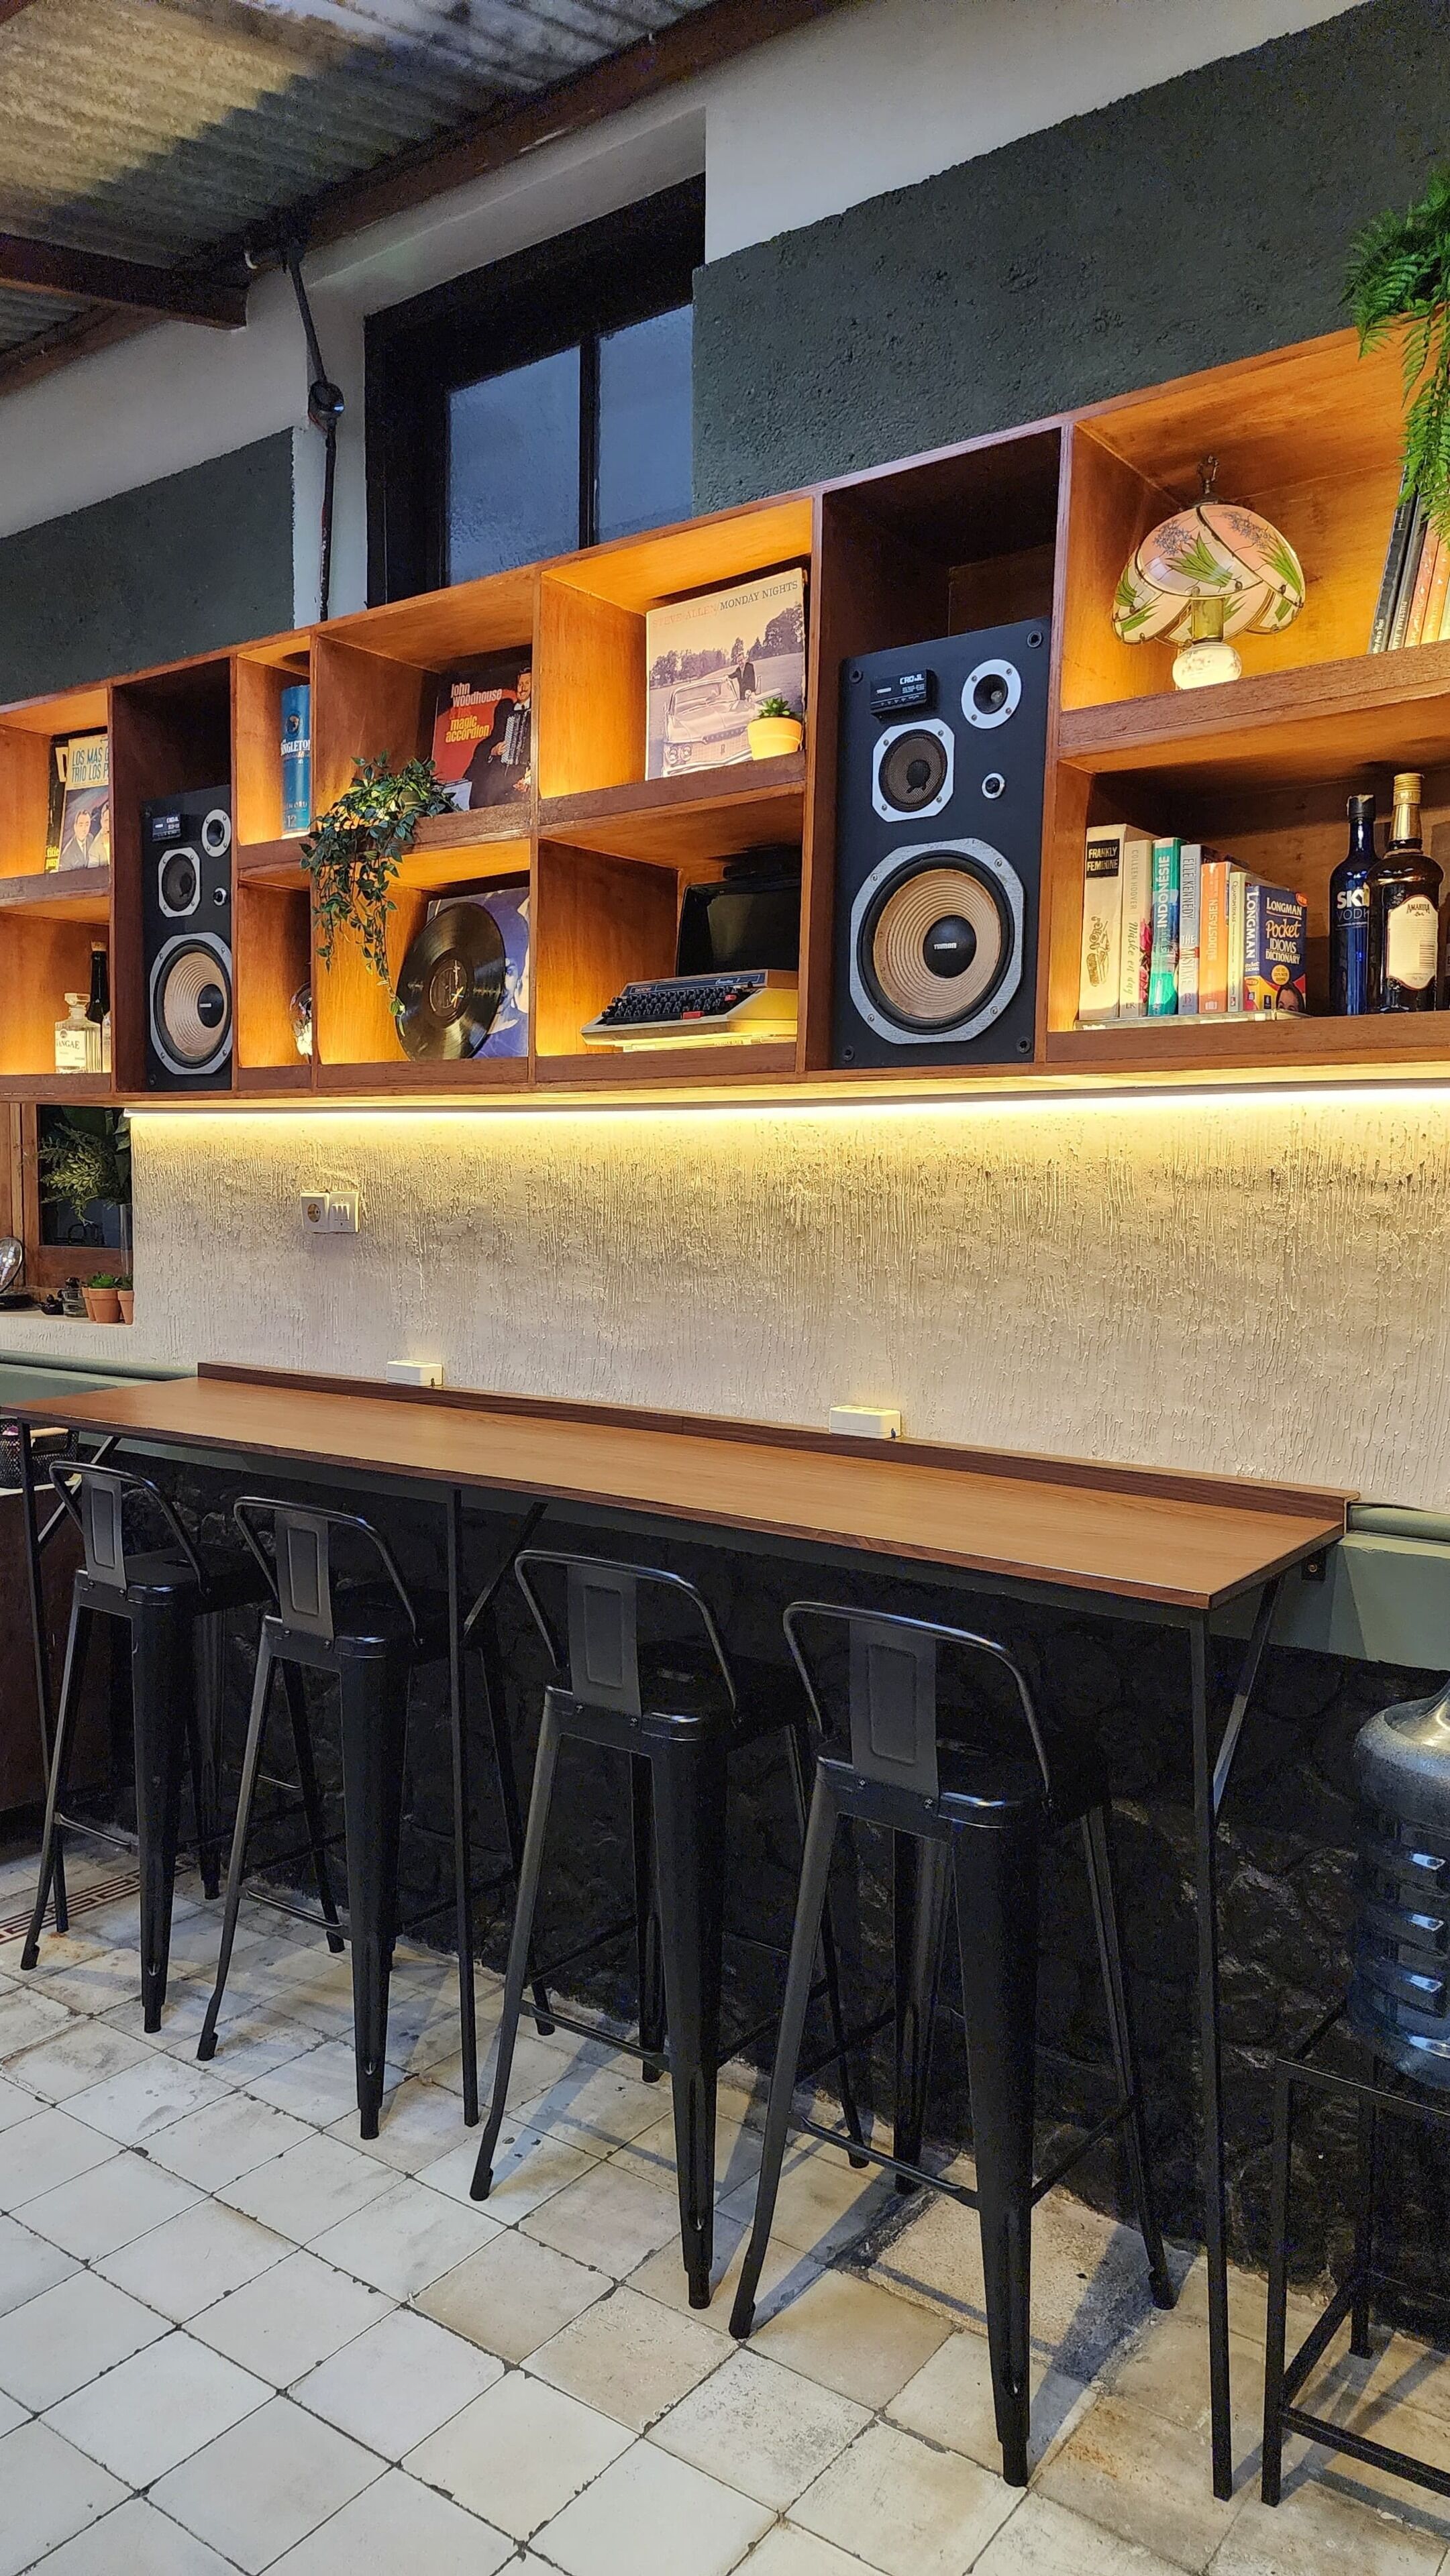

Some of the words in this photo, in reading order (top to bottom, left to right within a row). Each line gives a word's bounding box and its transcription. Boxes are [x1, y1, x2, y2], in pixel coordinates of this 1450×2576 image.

[652, 613, 682, 629] STEVE
[762, 580, 798, 599] NIGHTS
[450, 682, 470, 698] john
[453, 688, 503, 707] woodhouse
[450, 715, 478, 731] magic
[445, 724, 490, 743] accordion
[72, 749, 85, 766] LOS
[87, 747, 103, 764] MAS
[72, 765, 87, 783] TRIO
[89, 763, 101, 780] LOS
[1088, 846, 1118, 859] FRANKLY
[1087, 858, 1119, 872] FEMININE
[1130, 849, 1139, 880] COLLEEN
[1183, 859, 1194, 877] ELLE
[1129, 881, 1139, 910] HOOVER
[1155, 855, 1170, 929] INDONÉSIE
[1182, 881, 1194, 919] KENNEDY
[1266, 897, 1302, 916] LONGMAN
[1246, 891, 1259, 959] LONGMAN
[1265, 918, 1302, 938] Pocket
[1270, 938, 1297, 953] IDIOMS
[1180, 946, 1194, 985] MISTAKE
[1265, 949, 1300, 964] DICTIONARY
